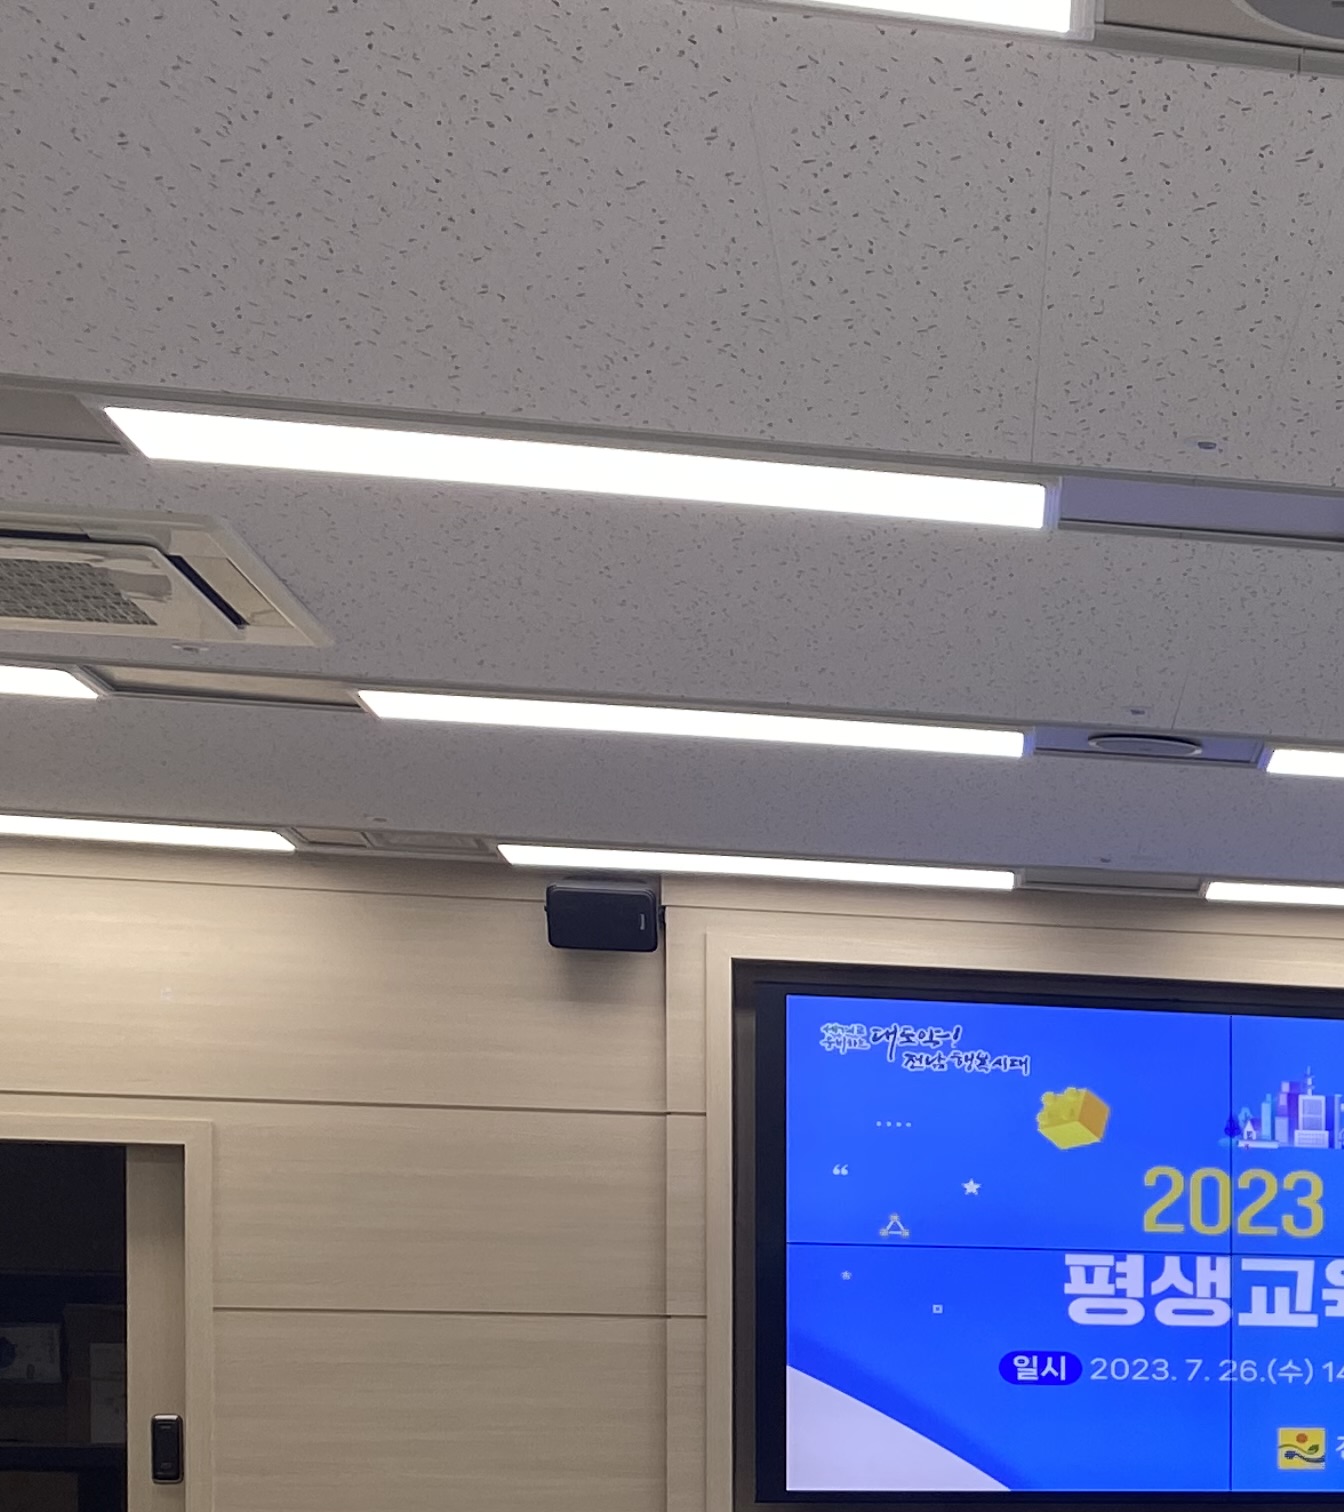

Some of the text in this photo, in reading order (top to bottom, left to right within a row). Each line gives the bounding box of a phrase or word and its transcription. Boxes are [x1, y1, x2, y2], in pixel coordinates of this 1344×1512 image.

[1143, 1166, 1324, 1238] 2023
[1012, 1354, 1067, 1381] 일시
[1090, 1358, 1177, 1382] 2023.
[1186, 1358, 1210, 1382] 7.
